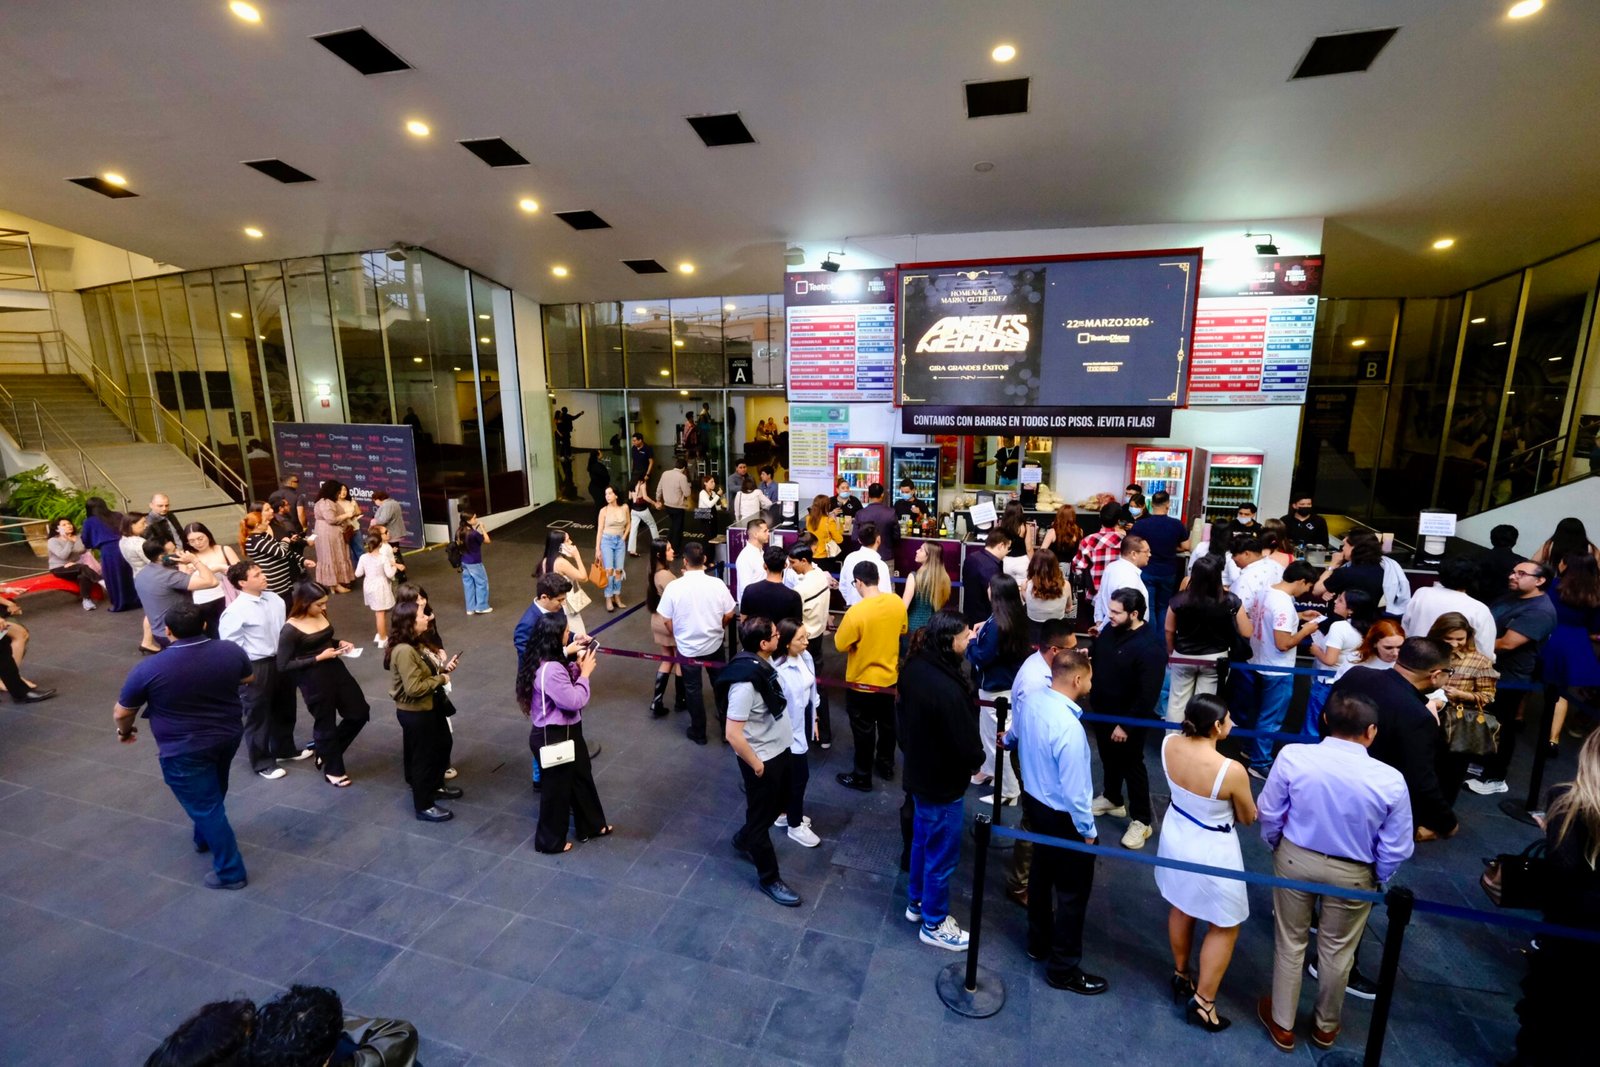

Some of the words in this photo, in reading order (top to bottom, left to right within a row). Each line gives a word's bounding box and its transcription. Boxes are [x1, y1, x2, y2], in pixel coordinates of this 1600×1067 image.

[951, 289, 988, 297] HOMENAJE
[1123, 317, 1150, 327] 2026
[982, 363, 1009, 371] ÉXITOS
[1366, 362, 1378, 378] B
[735, 367, 746, 383] A
[913, 414, 955, 426] CONTAMOS
[956, 415, 973, 427] CON
[974, 416, 1007, 427] BARRAS
[1008, 416, 1020, 427] EN
[1021, 416, 1049, 427] TODOS
[1050, 416, 1066, 427] LOS
[1068, 416, 1096, 427] PISOS.
[1097, 416, 1125, 427] ¡EVITA
[1127, 416, 1155, 428] FILAS!
[349, 487, 374, 497] oDiana
